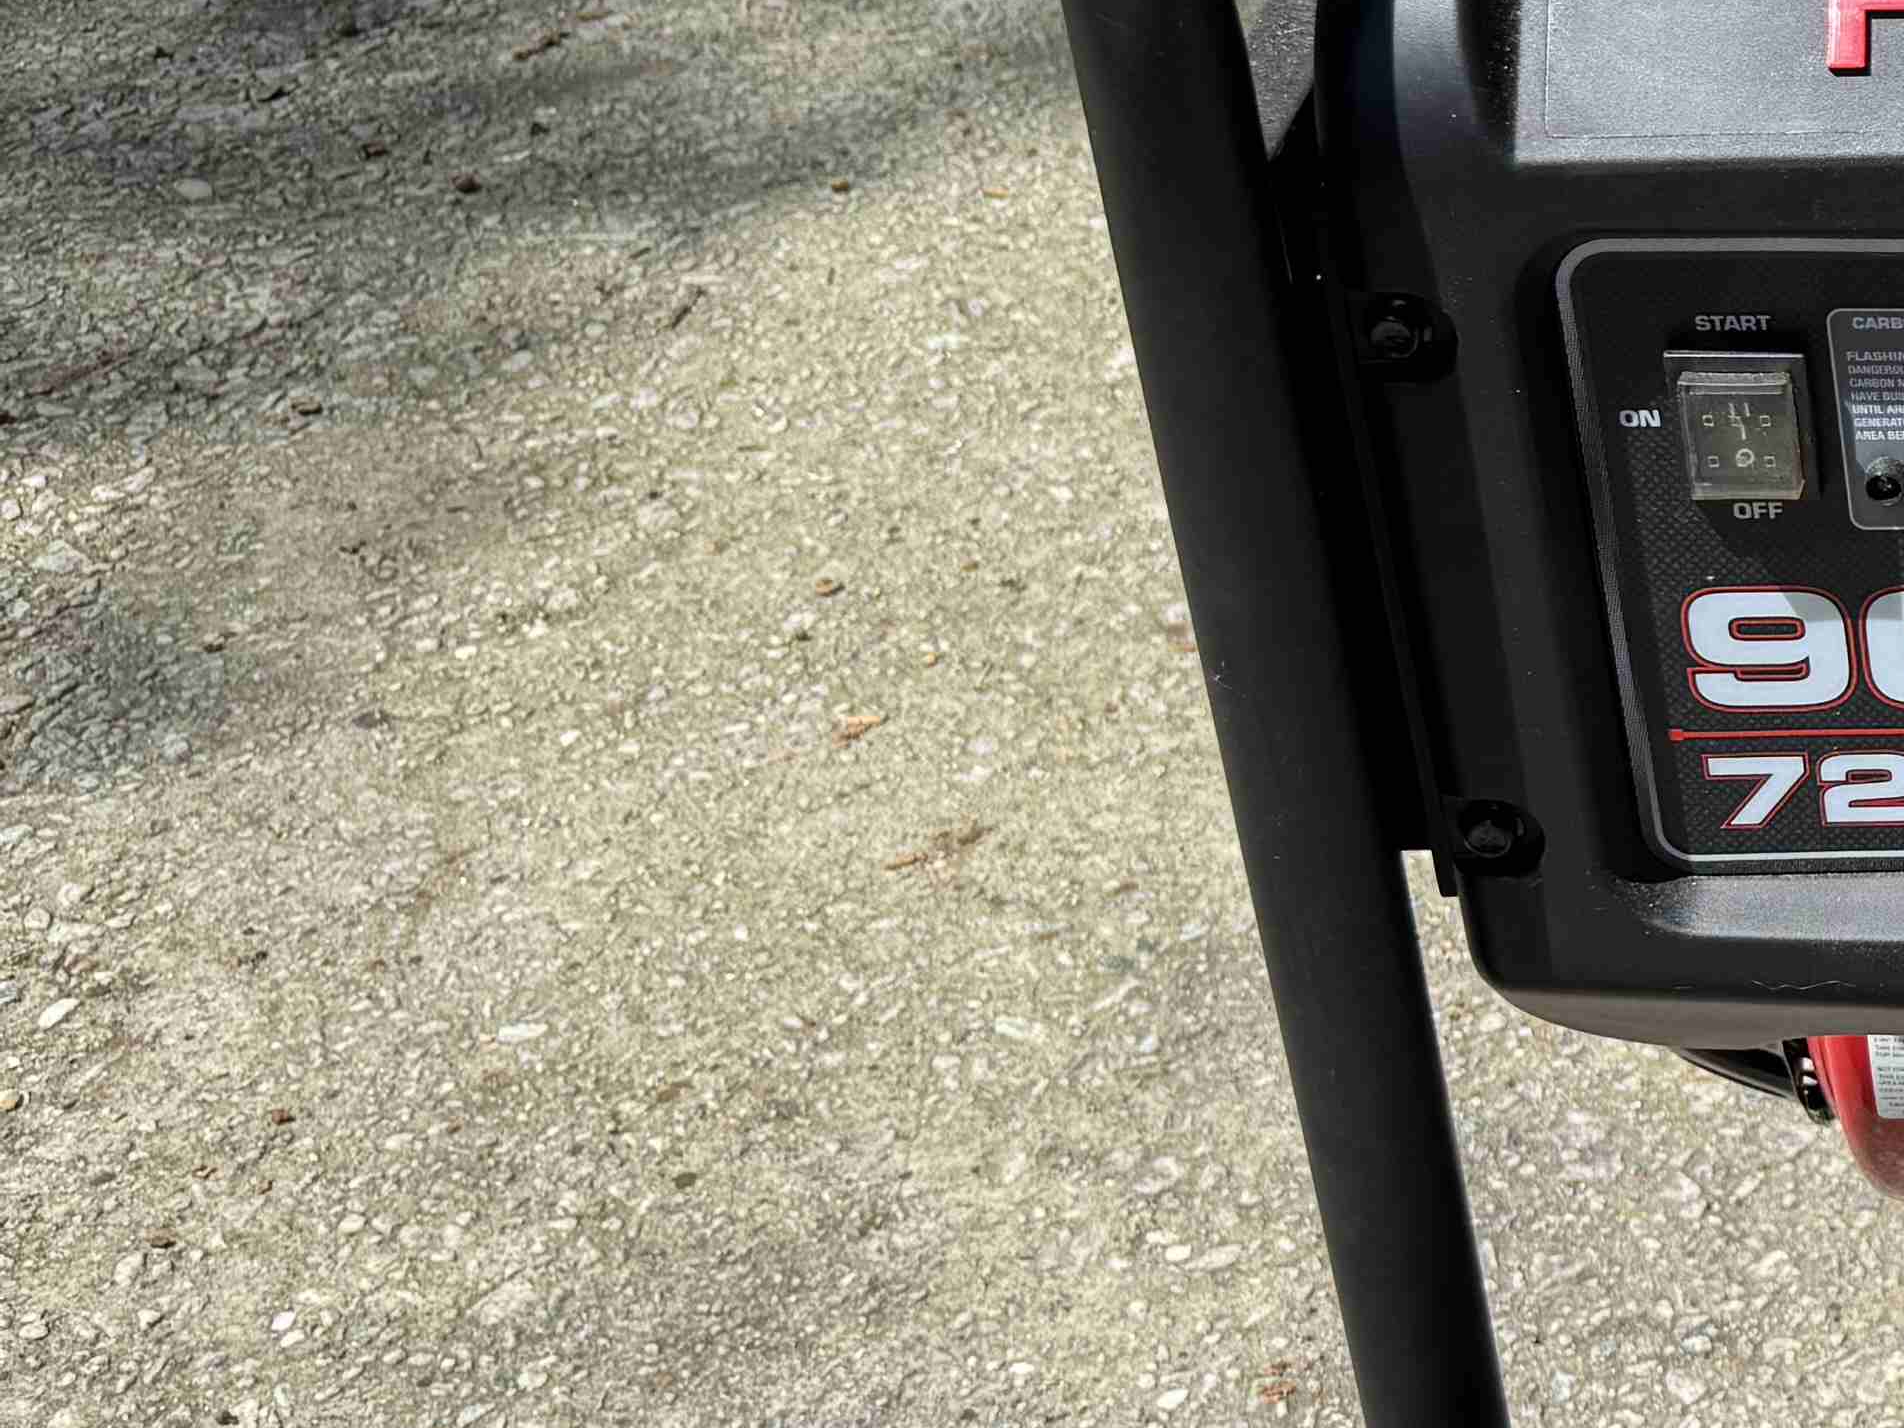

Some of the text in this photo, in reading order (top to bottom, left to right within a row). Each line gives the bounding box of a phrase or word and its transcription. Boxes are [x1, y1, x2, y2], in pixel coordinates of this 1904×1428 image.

[1694, 314, 1772, 333] START
[1849, 377, 1894, 389] CARBON
[1851, 391, 1880, 402] HAVE
[1851, 404, 1884, 415] UNTIL
[1618, 409, 1662, 429] ON
[1855, 430, 1885, 441] AREA
[1733, 501, 1784, 520] OFF
